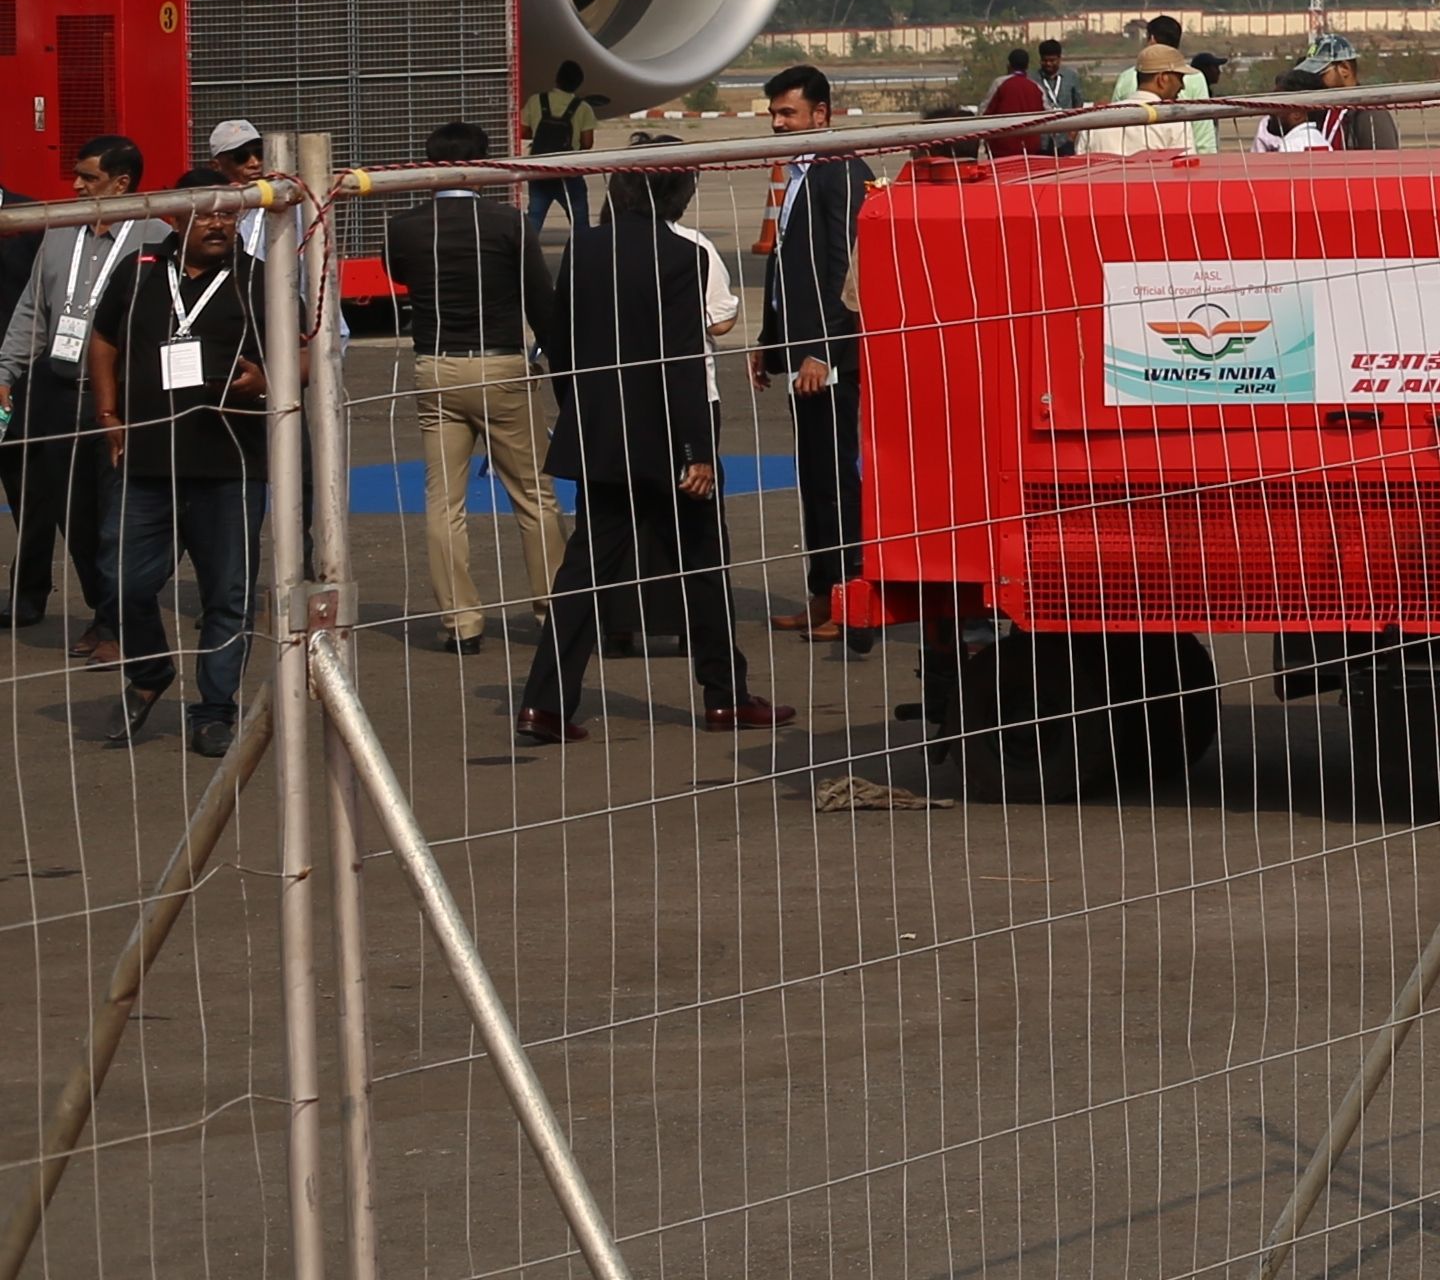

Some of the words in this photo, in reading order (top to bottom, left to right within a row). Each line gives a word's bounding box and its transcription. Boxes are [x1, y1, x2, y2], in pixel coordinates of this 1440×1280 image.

[164, 7, 173, 30] 3
[1133, 286, 1165, 296] Official
[1167, 286, 1202, 296] Ground
[1144, 367, 1212, 382] WINGS
[1218, 366, 1276, 381] INDIA
[1234, 383, 1276, 394] 2024
[1350, 378, 1391, 393] AI
